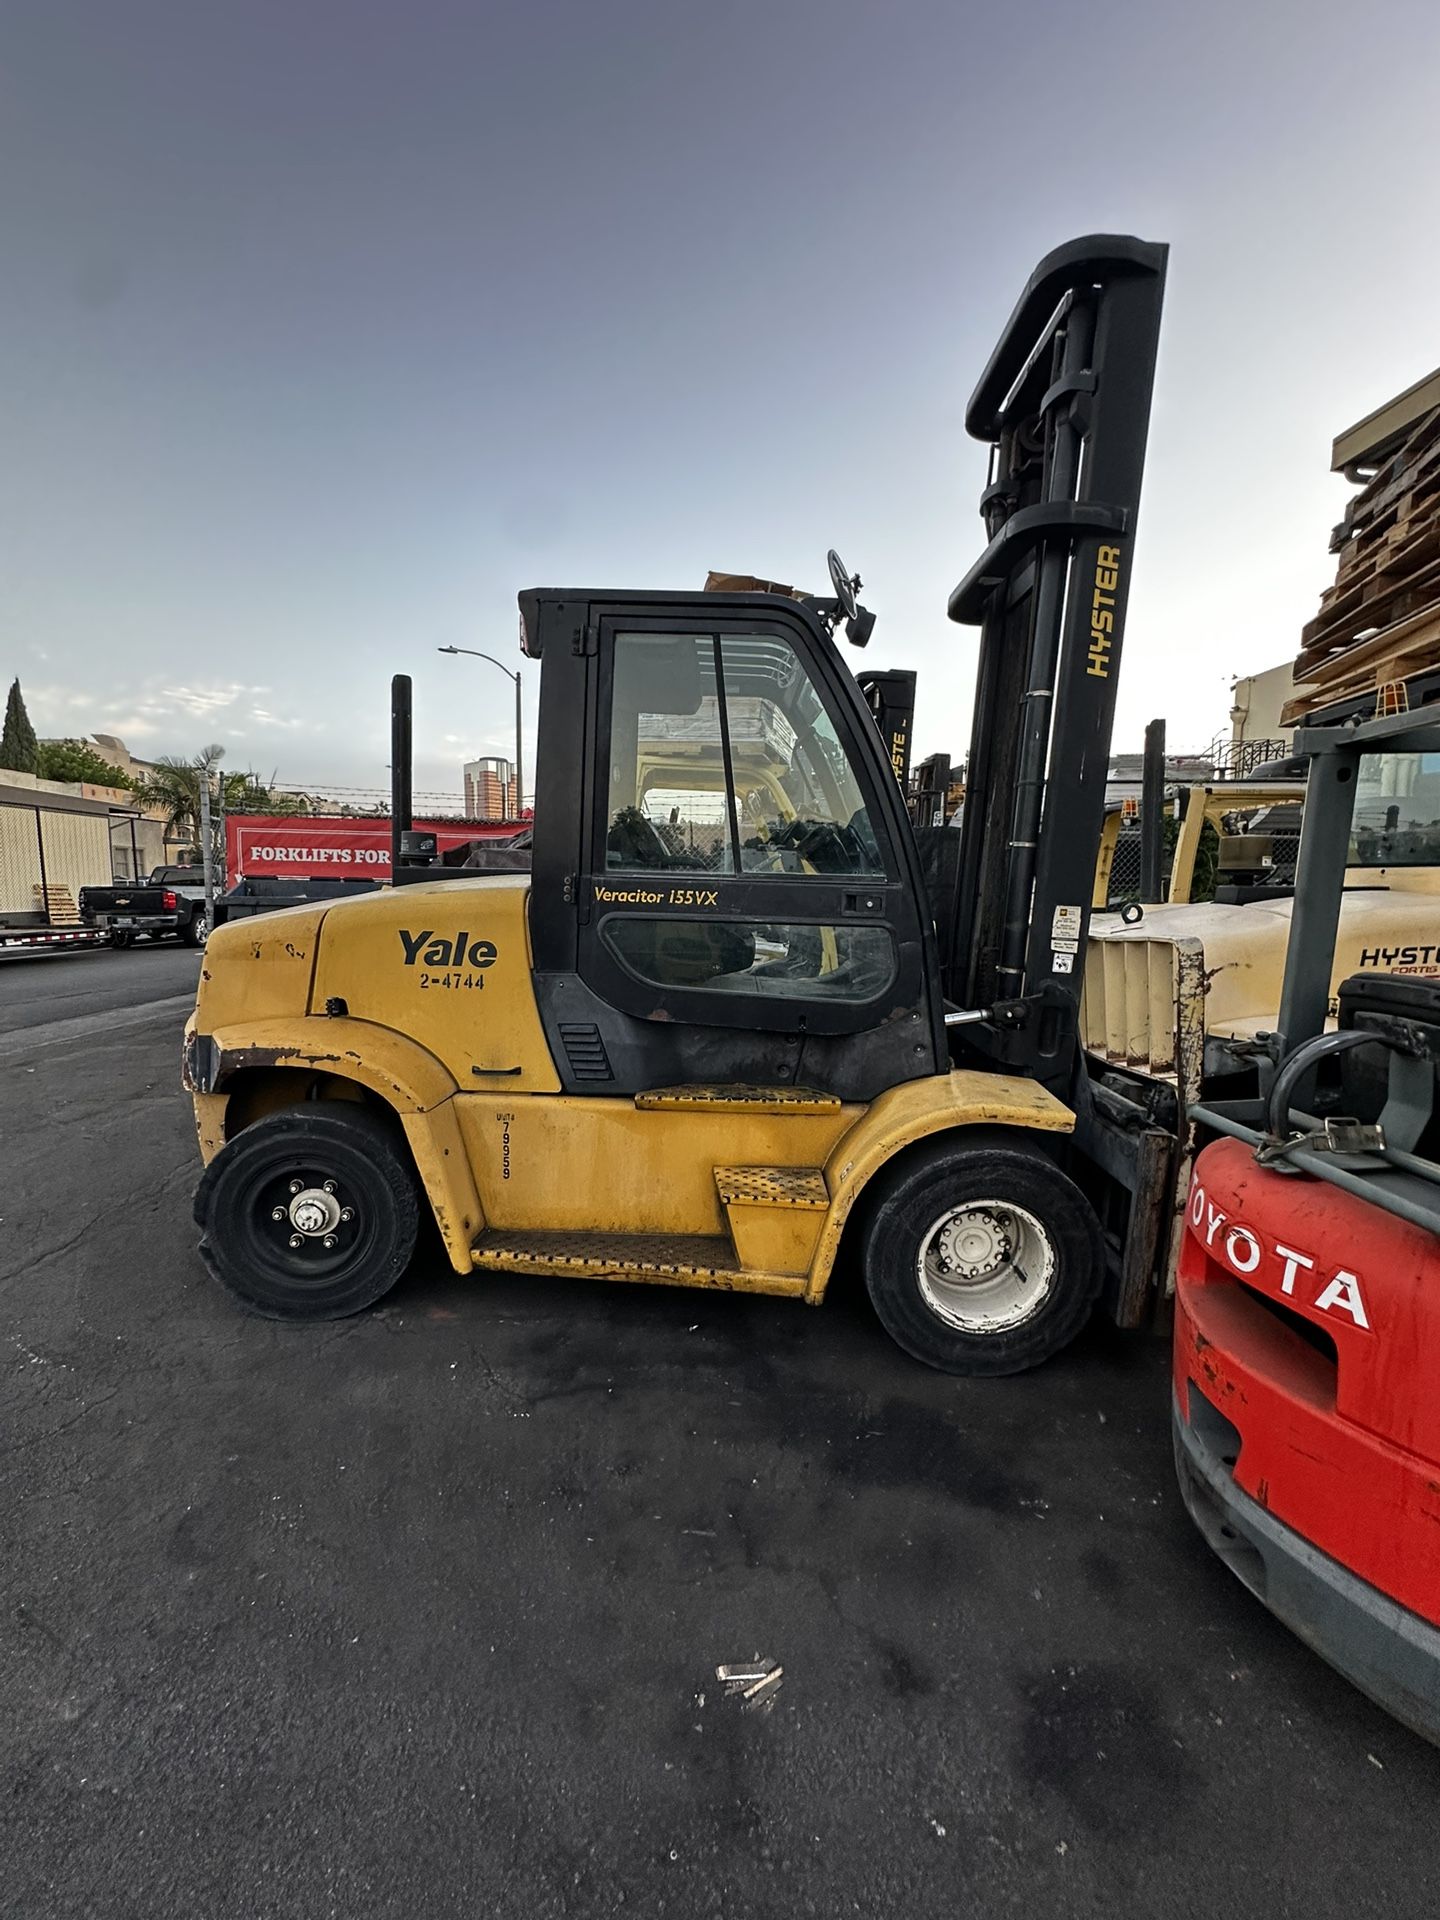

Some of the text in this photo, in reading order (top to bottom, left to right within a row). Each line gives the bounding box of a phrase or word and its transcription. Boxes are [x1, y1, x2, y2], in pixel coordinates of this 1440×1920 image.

[1087, 545, 1120, 678] HYSTER
[251, 846, 391, 864] FORKLIFTS FOR
[594, 886, 718, 906] Veracitor 155VX
[399, 930, 498, 968] Yale
[1360, 946, 1440, 967] HYST
[1391, 966, 1438, 975] FORTIS
[420, 973, 485, 990] 2-4744
[1189, 1171, 1370, 1329] TOYOTA
